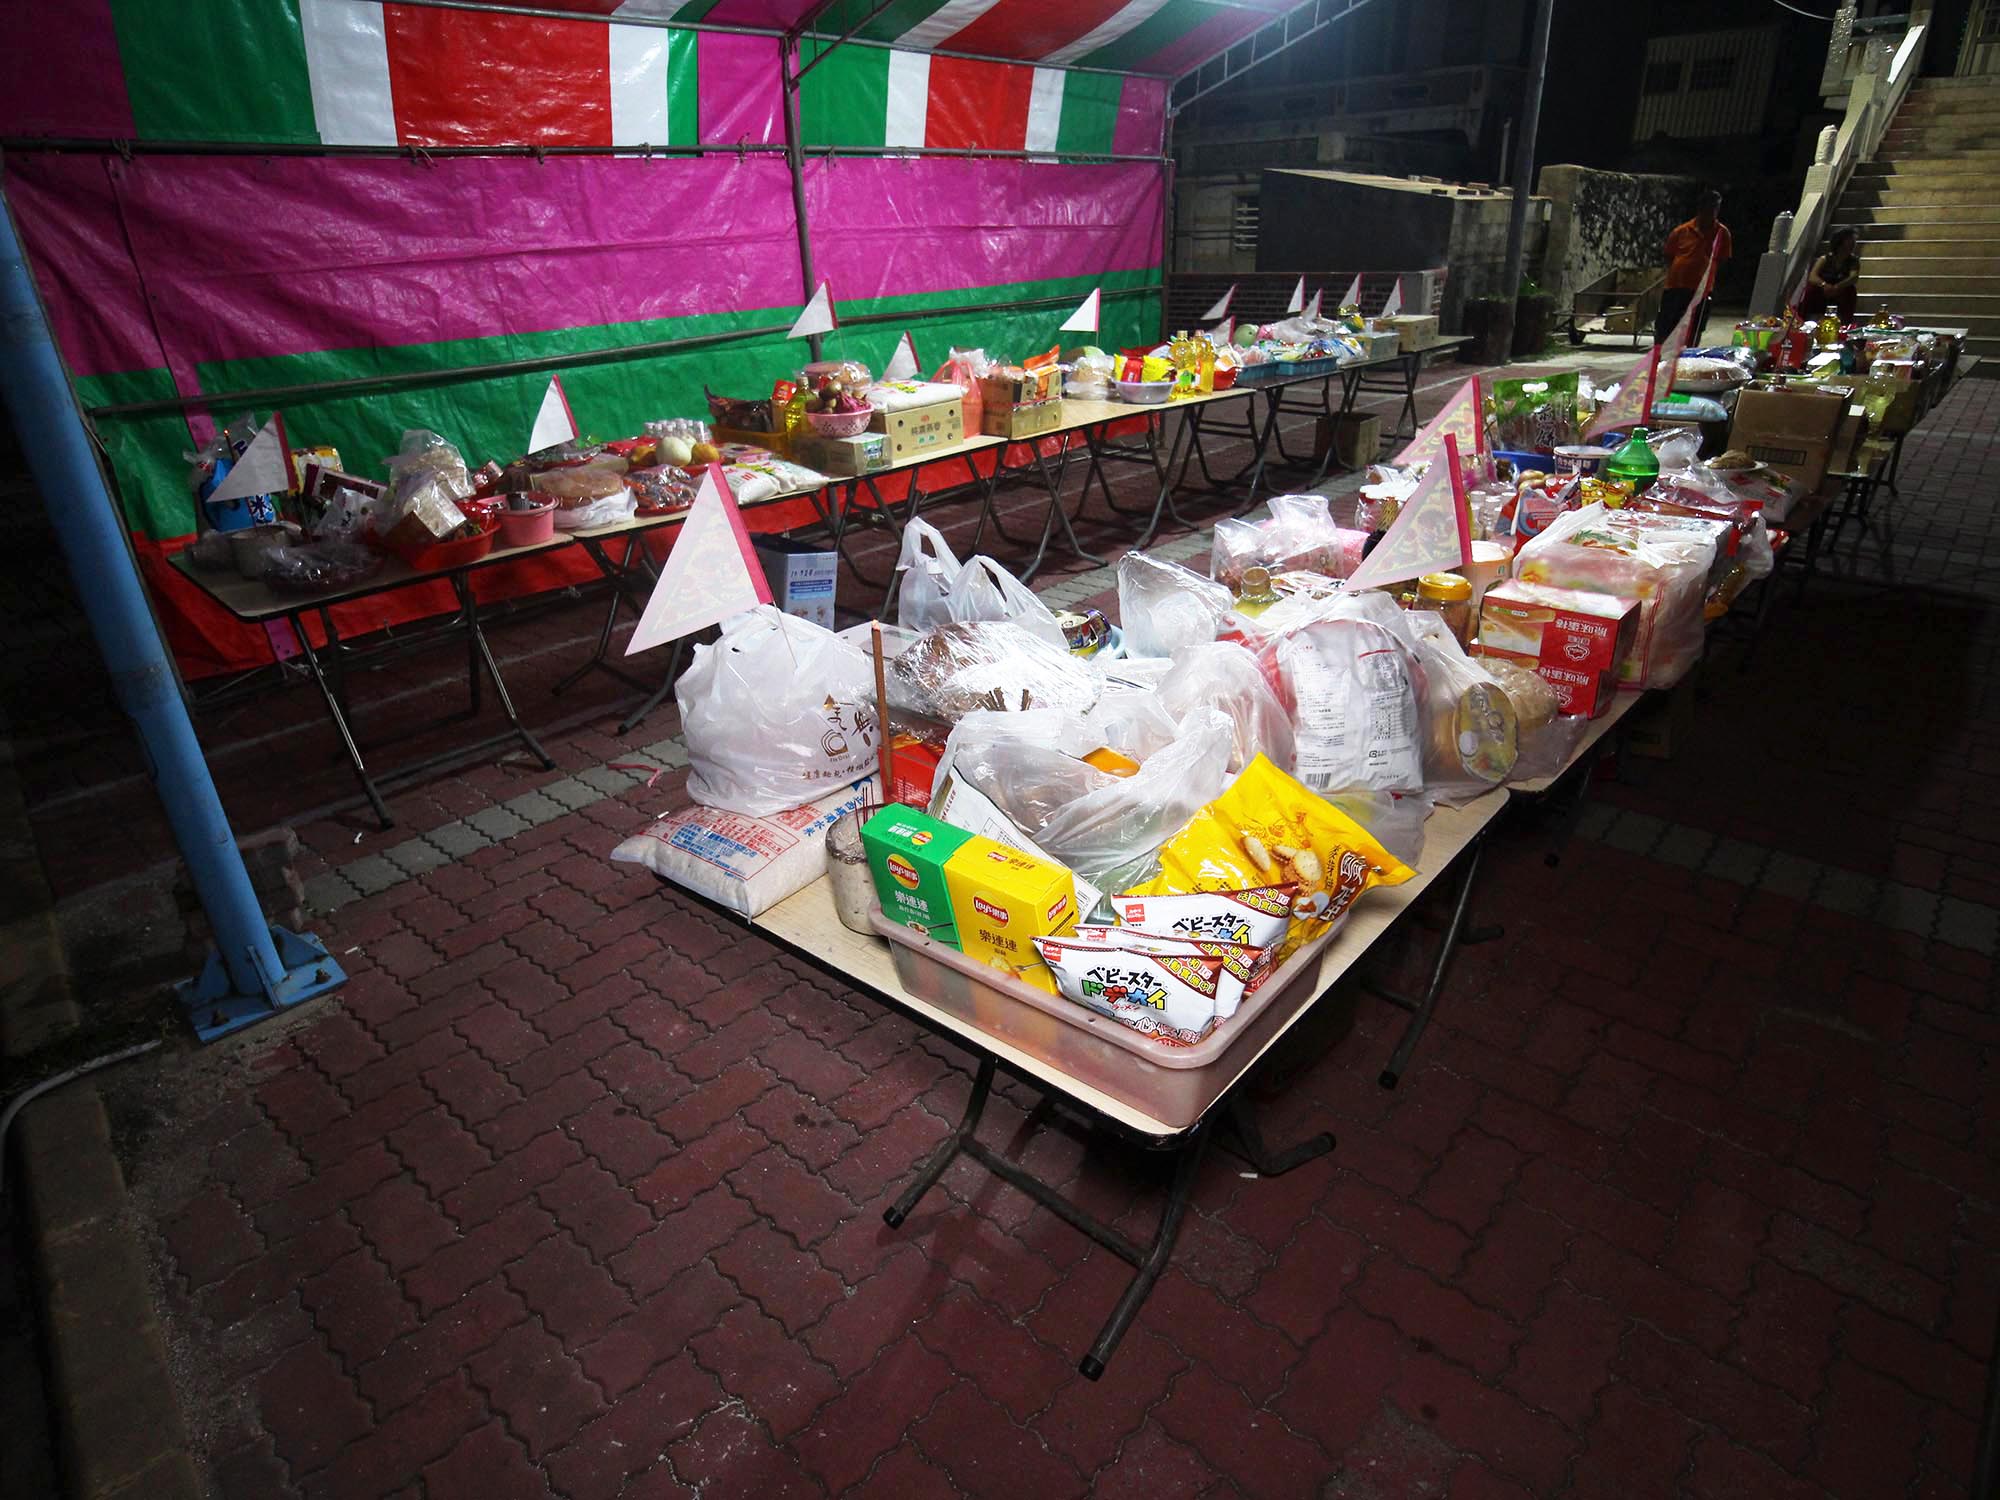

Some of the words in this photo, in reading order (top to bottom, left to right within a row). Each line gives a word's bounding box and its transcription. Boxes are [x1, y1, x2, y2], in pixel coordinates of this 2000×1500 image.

[1172, 913, 1247, 931] ベビースター
[1086, 966, 1163, 989] ベビースター
[1082, 979, 1169, 1010] ドデカイ
